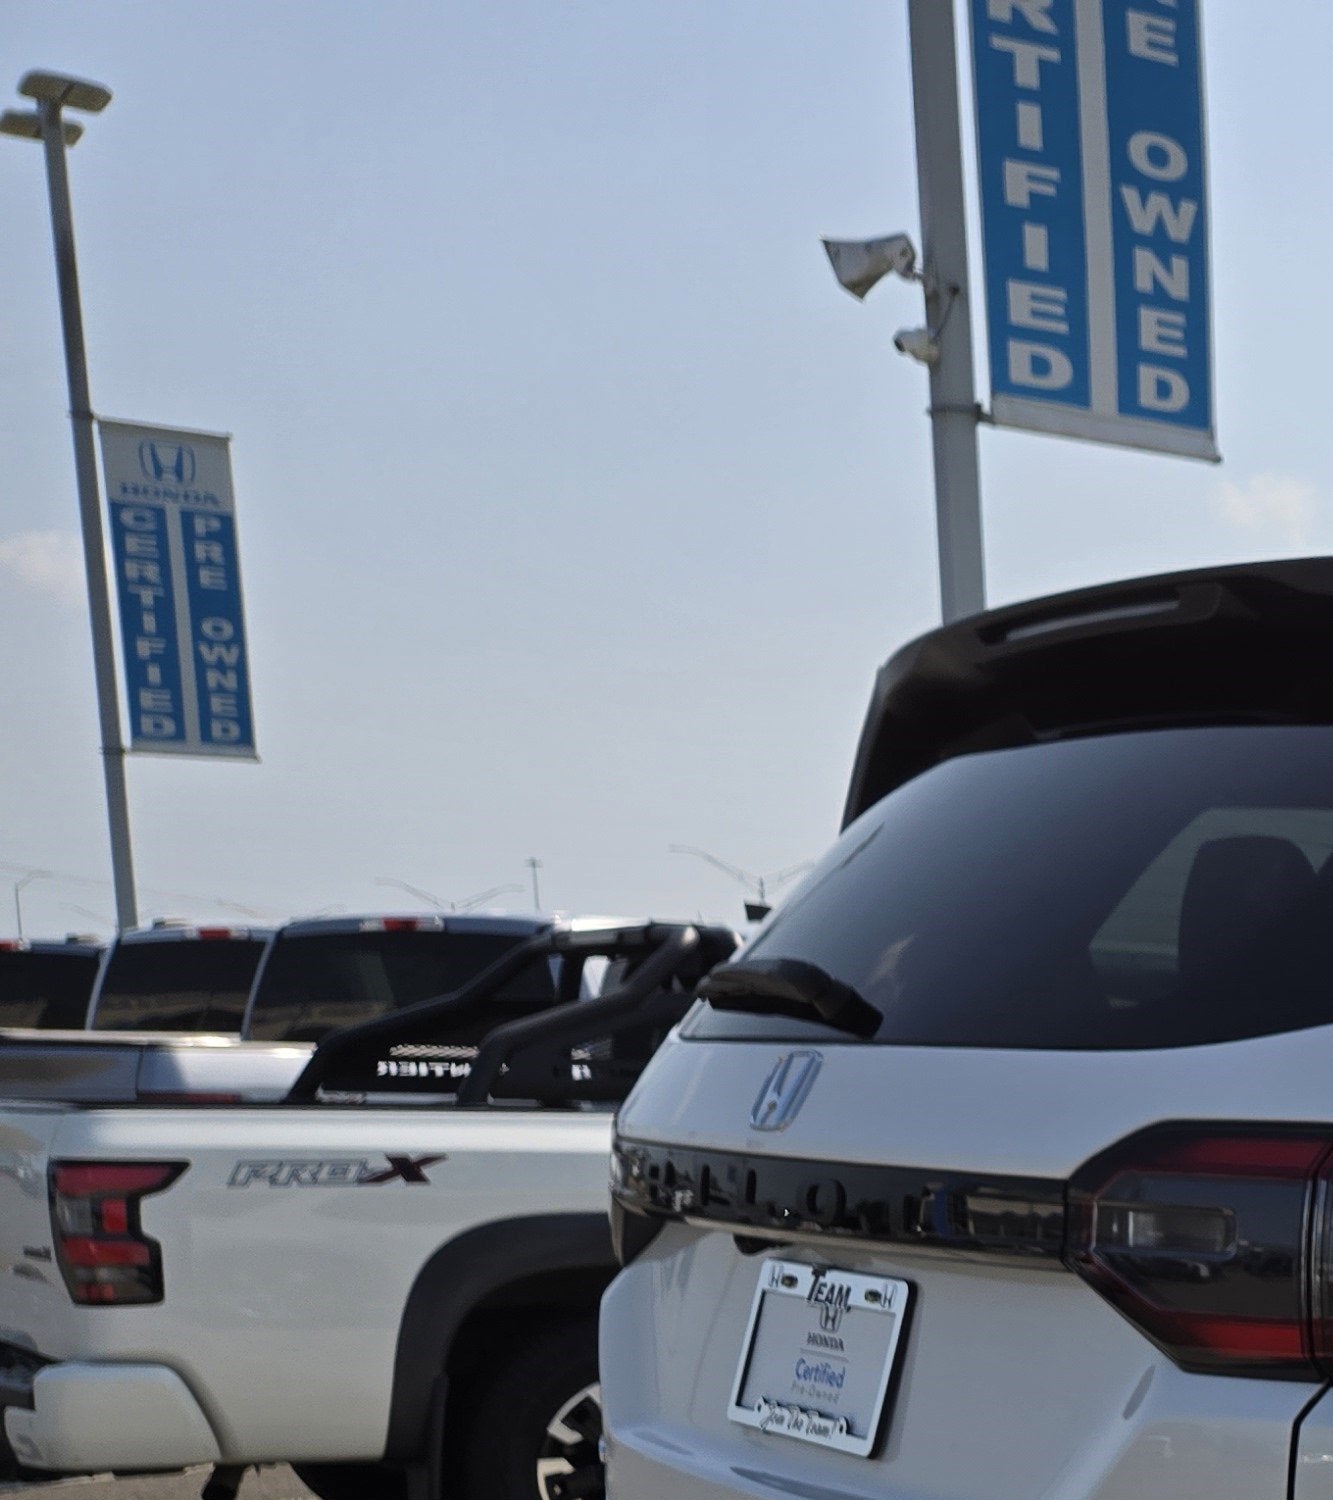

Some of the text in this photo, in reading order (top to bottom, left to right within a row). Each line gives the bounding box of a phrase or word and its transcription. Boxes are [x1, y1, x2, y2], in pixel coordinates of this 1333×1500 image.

[1119, 130, 1198, 414] OWNED
[118, 482, 221, 506] HONDA
[118, 505, 177, 739] CERTIFIED
[193, 510, 241, 742] PRE OWNED
[795, 1357, 847, 1389] Certified
[806, 1331, 845, 1352] HONDA
